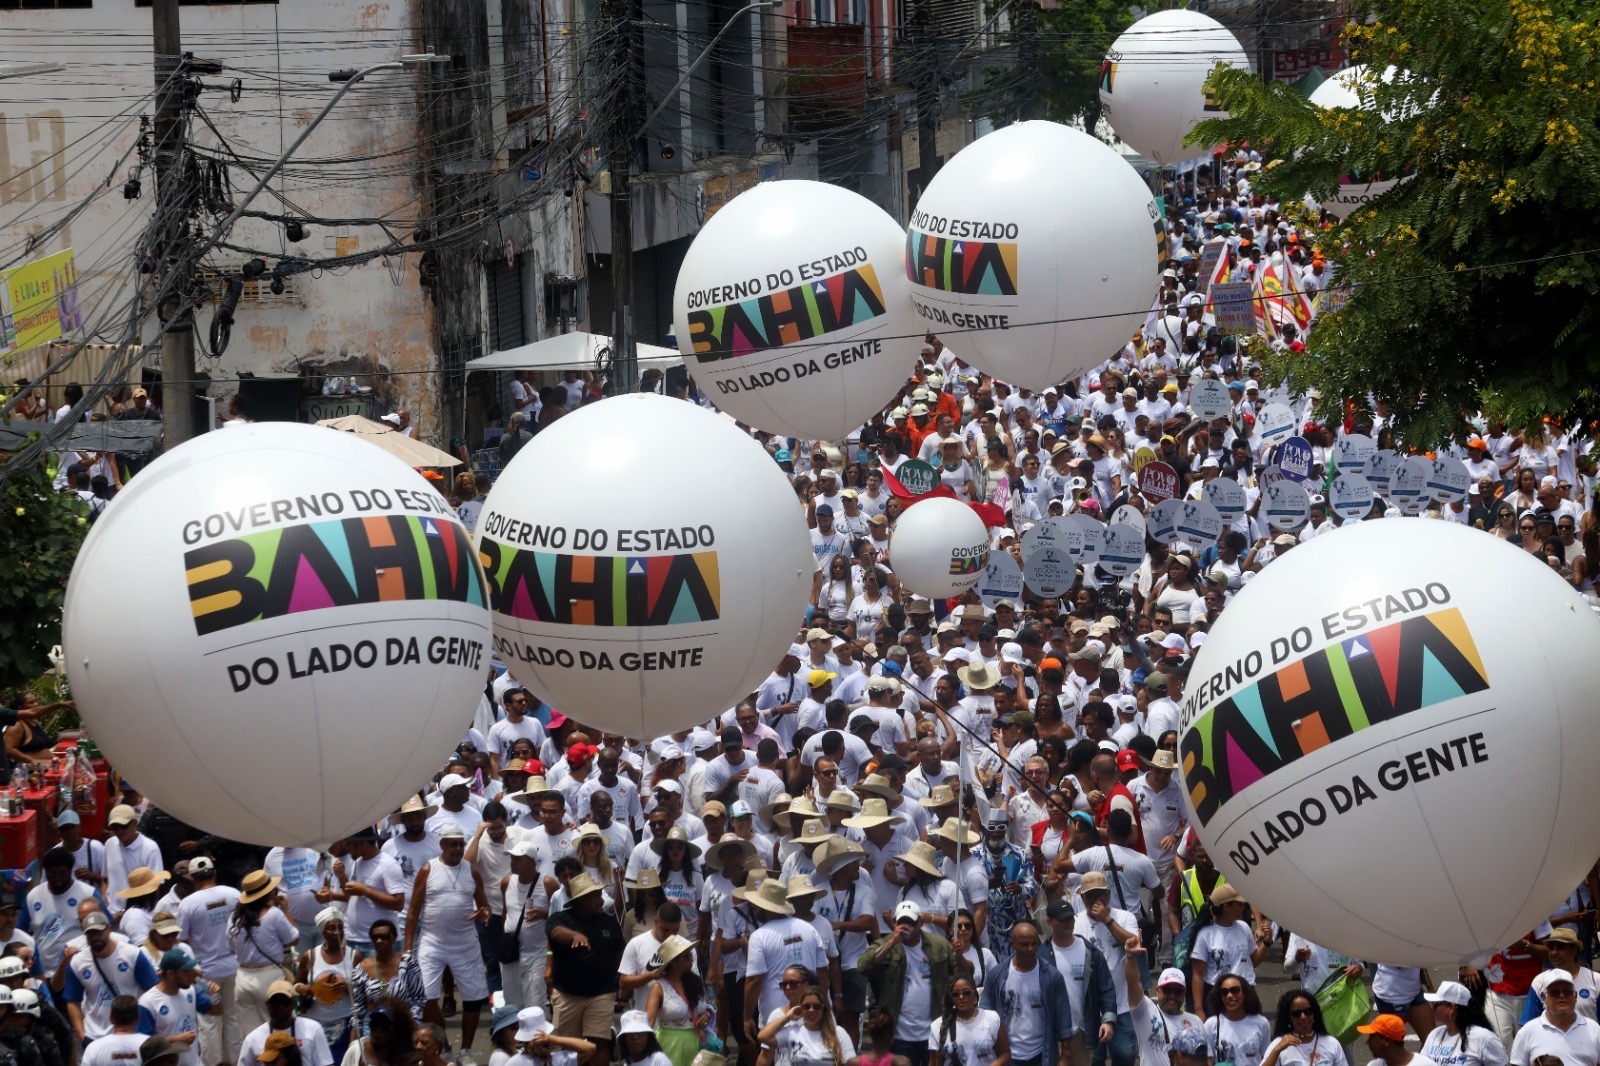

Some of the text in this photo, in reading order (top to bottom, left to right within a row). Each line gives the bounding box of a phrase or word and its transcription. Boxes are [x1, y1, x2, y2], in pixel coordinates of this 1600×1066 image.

[928, 216, 947, 234] DO
[949, 219, 1019, 240] ESTADO
[687, 246, 868, 309] GOVERNO DO ESTADO
[687, 263, 886, 364] BAHIA
[932, 306, 952, 326] DA
[952, 312, 1010, 330] GENTE
[716, 338, 882, 395] DO LADO DA GENTE
[182, 491, 345, 546] GOVERNO
[349, 488, 393, 512] DO
[485, 510, 715, 552] GOVERNO DO ESTADO
[184, 514, 489, 637] BAHIA
[479, 535, 720, 627] BAHIA
[227, 635, 484, 693] DO LADO DA GENTE
[493, 633, 703, 672] DO LADO DA GENTE
[1179, 582, 1451, 735] GOVERNO DO ESTADO
[1180, 606, 1490, 828] BAHIA
[1229, 732, 1489, 875] DO LADO DA GENTE
